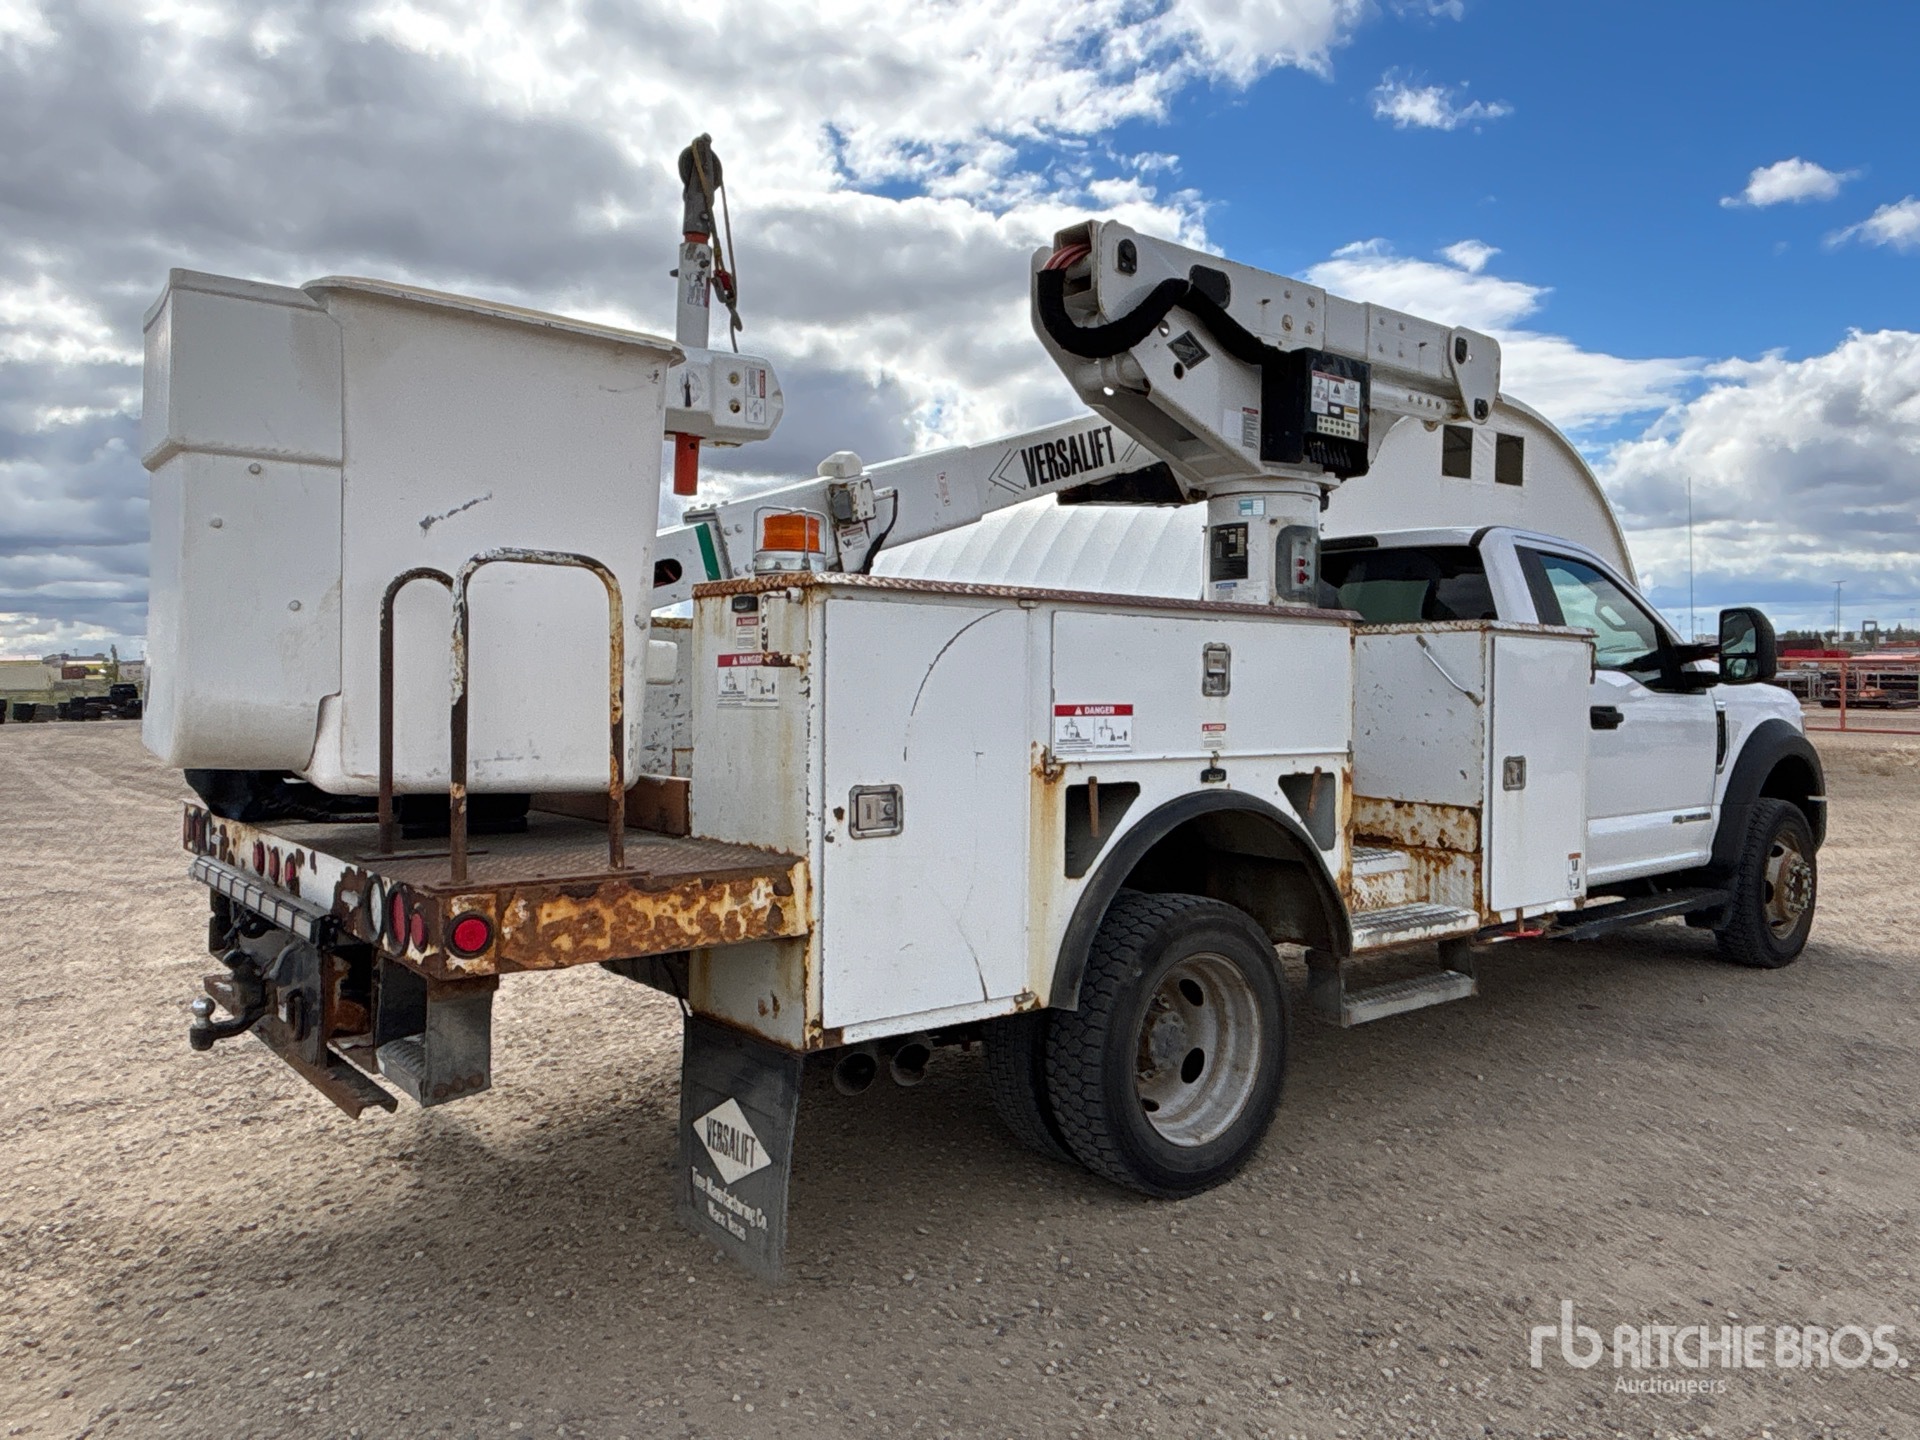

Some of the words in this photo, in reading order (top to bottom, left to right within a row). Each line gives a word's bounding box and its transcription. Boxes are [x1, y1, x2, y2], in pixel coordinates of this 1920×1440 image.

[1020, 425, 1115, 488] VERSALIFT
[1084, 705, 1115, 715] DANGER
[706, 1116, 756, 1168] VERSALIFT
